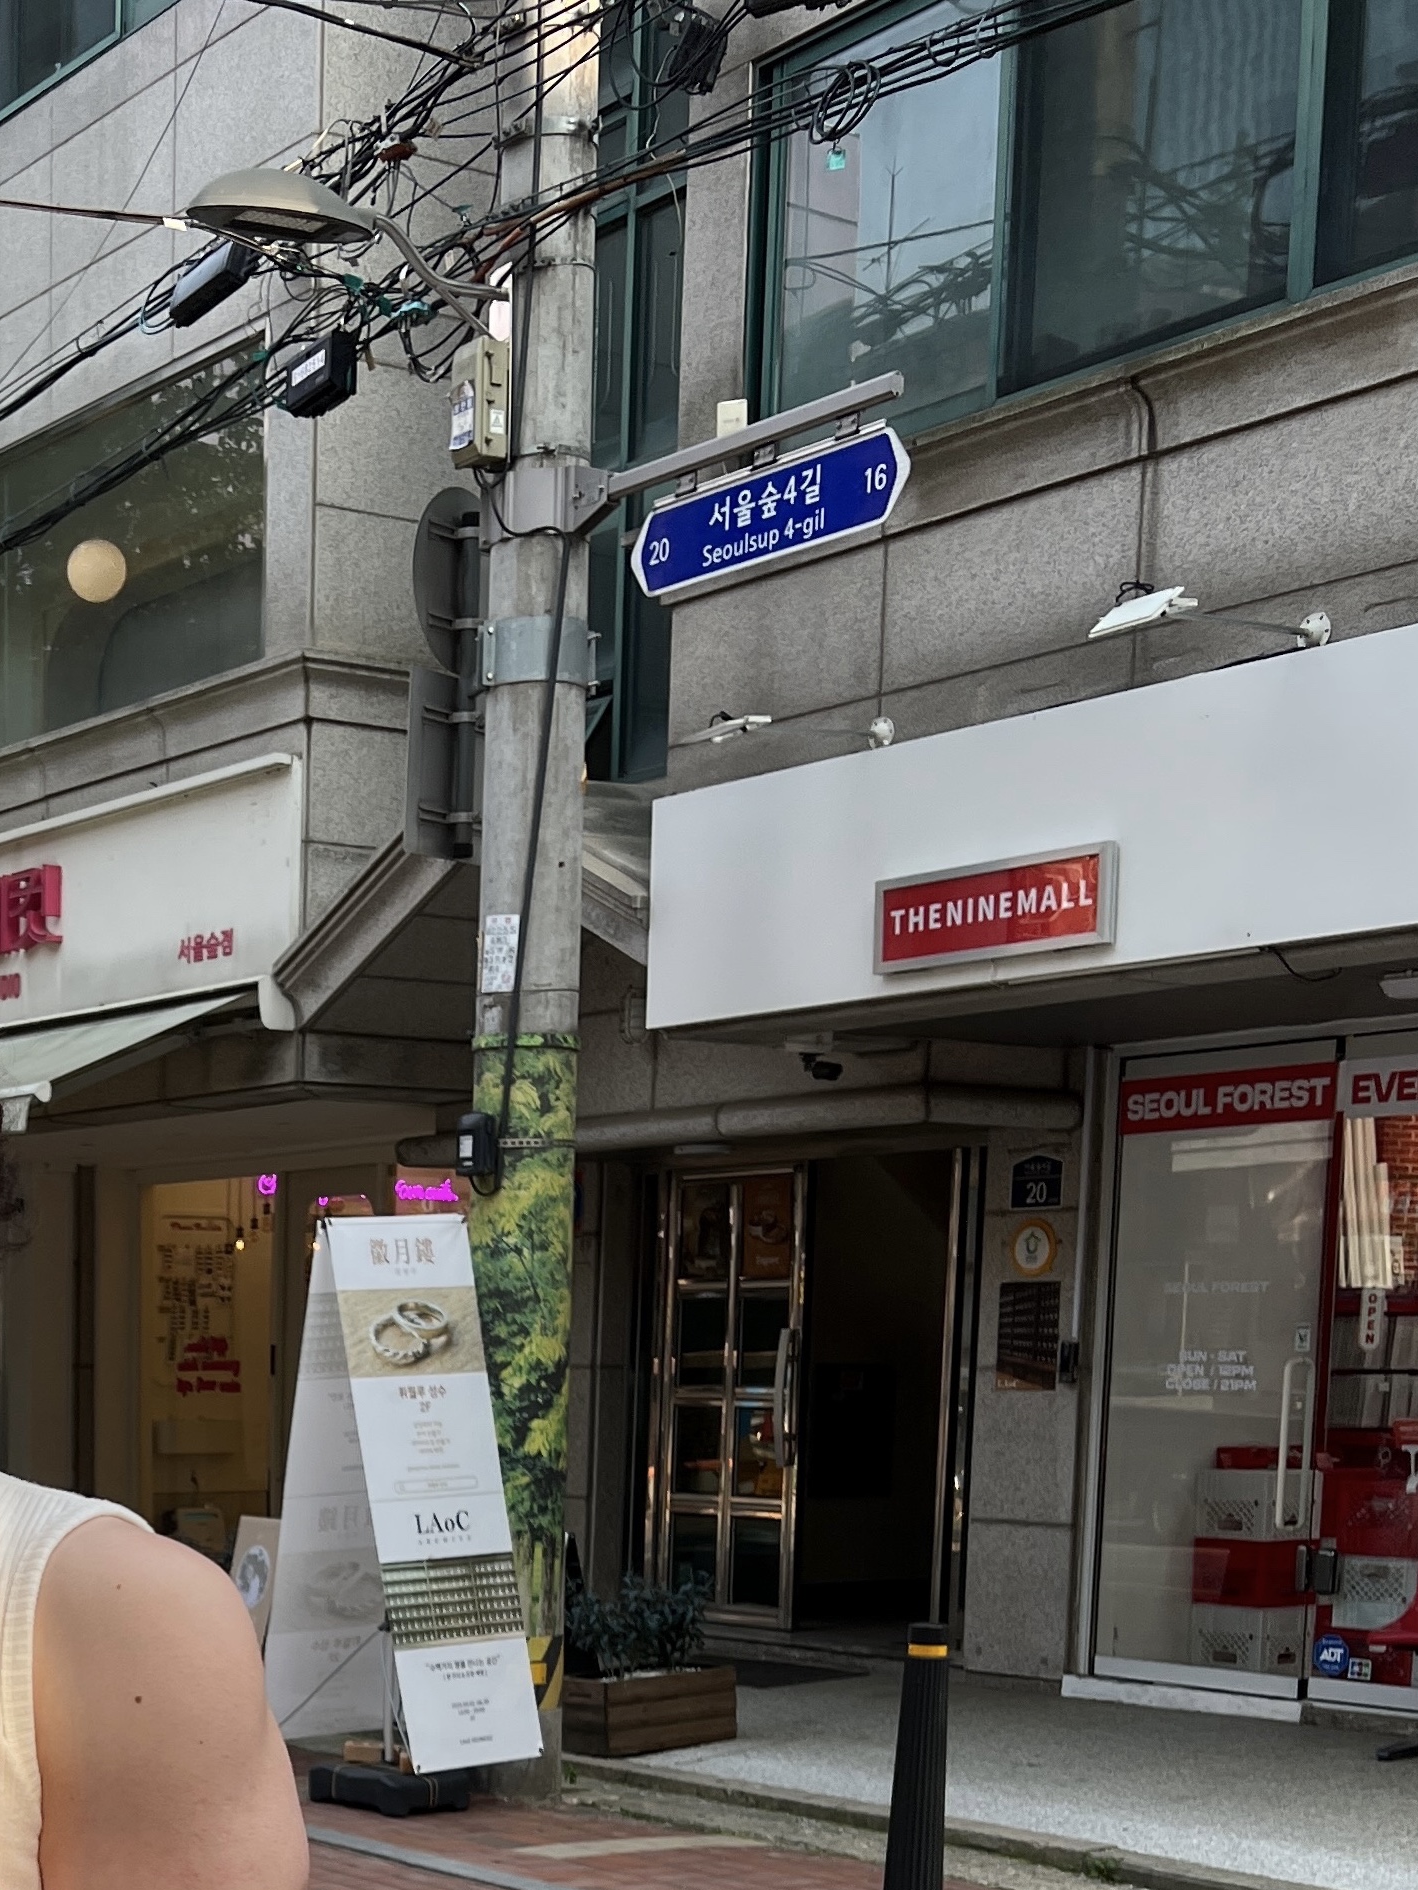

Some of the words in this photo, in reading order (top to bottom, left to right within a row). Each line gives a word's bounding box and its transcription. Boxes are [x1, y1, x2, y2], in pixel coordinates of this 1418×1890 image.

[864, 463, 888, 494] 16
[708, 463, 823, 532] 서울숲4길
[649, 537, 670, 566] 20
[702, 526, 780, 567] Seoulsup
[783, 507, 825, 542] 4-gil
[890, 879, 1093, 935] THENINEMALL
[177, 927, 235, 964] 서울숲점
[1127, 1088, 1212, 1121] SEOUL
[1216, 1077, 1331, 1114] FOREST
[1026, 1181, 1047, 1204] 20
[1365, 1293, 1380, 1345] OPEN
[1167, 1364, 1204, 1377] OPEN
[1179, 1350, 1208, 1363] SUN
[1217, 1350, 1248, 1363] SAT
[1165, 1378, 1210, 1391] CLOSE
[1319, 1648, 1344, 1664] ADT
